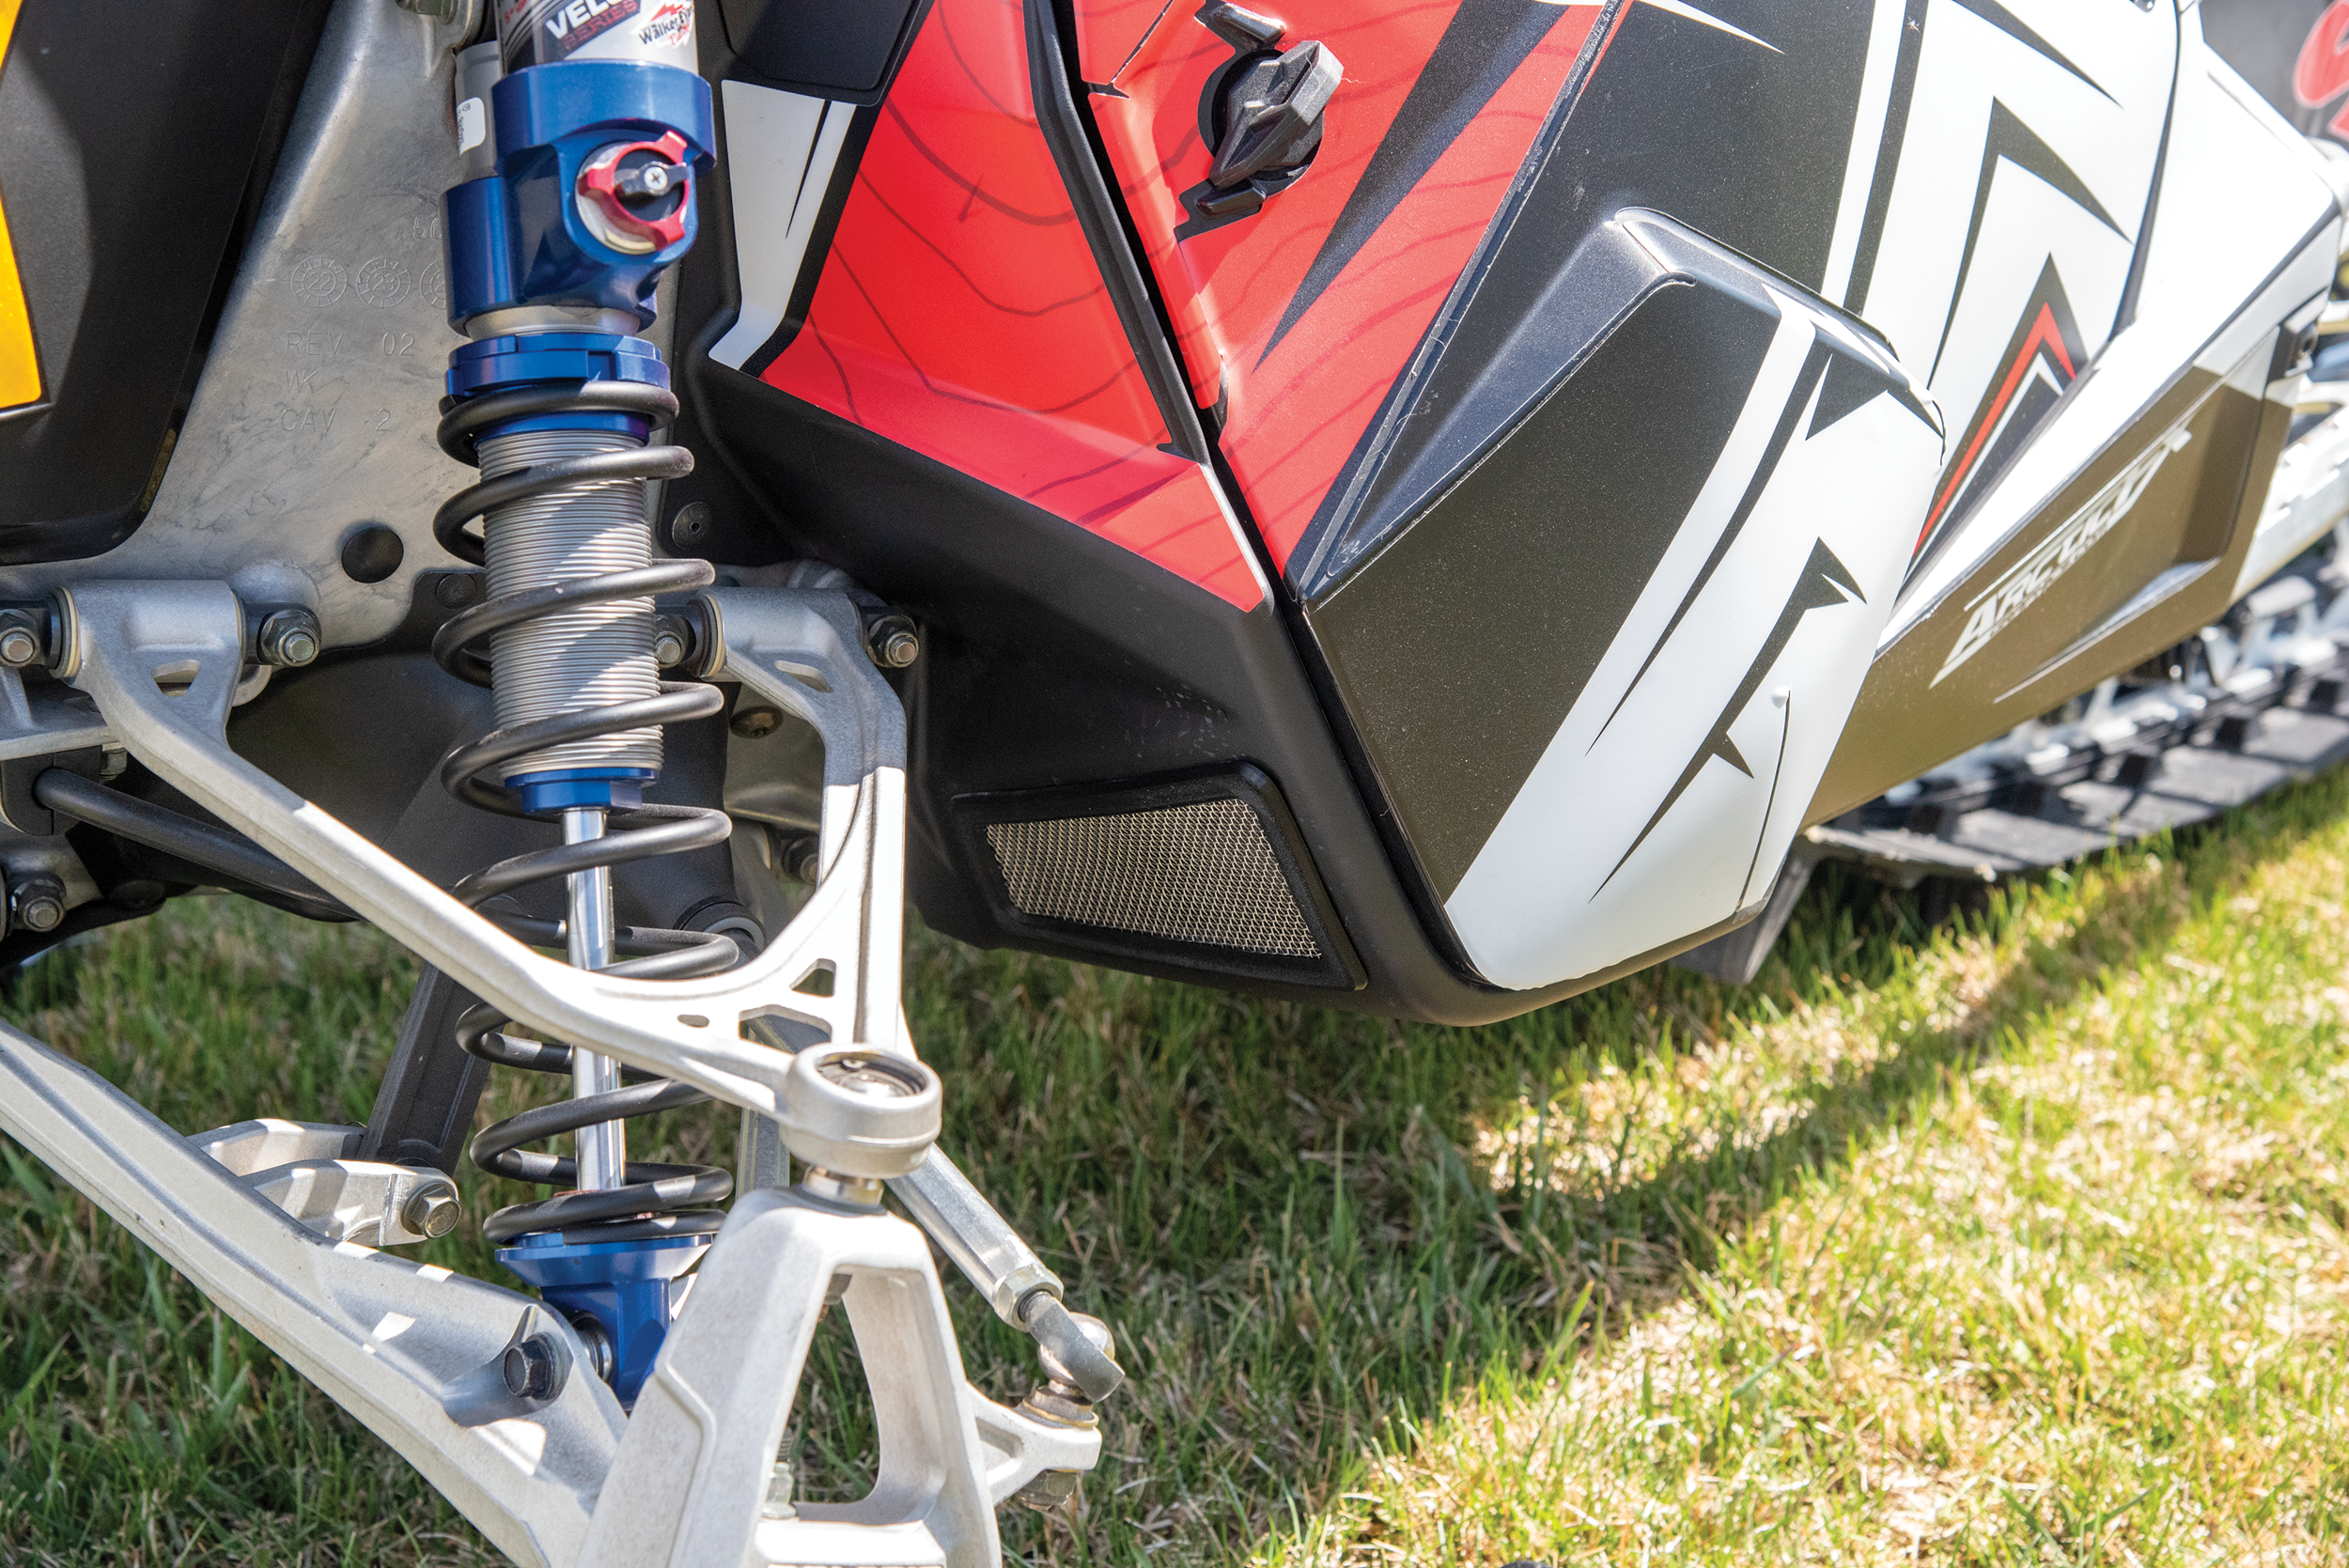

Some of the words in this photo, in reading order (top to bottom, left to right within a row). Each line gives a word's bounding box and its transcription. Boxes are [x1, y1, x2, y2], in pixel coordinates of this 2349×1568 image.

[544, 0, 625, 39] VEL
[562, 0, 639, 47] SERIES
[286, 332, 344, 356] REV
[381, 332, 415, 357] 02
[281, 408, 338, 432] CAV
[376, 408, 391, 432] 2
